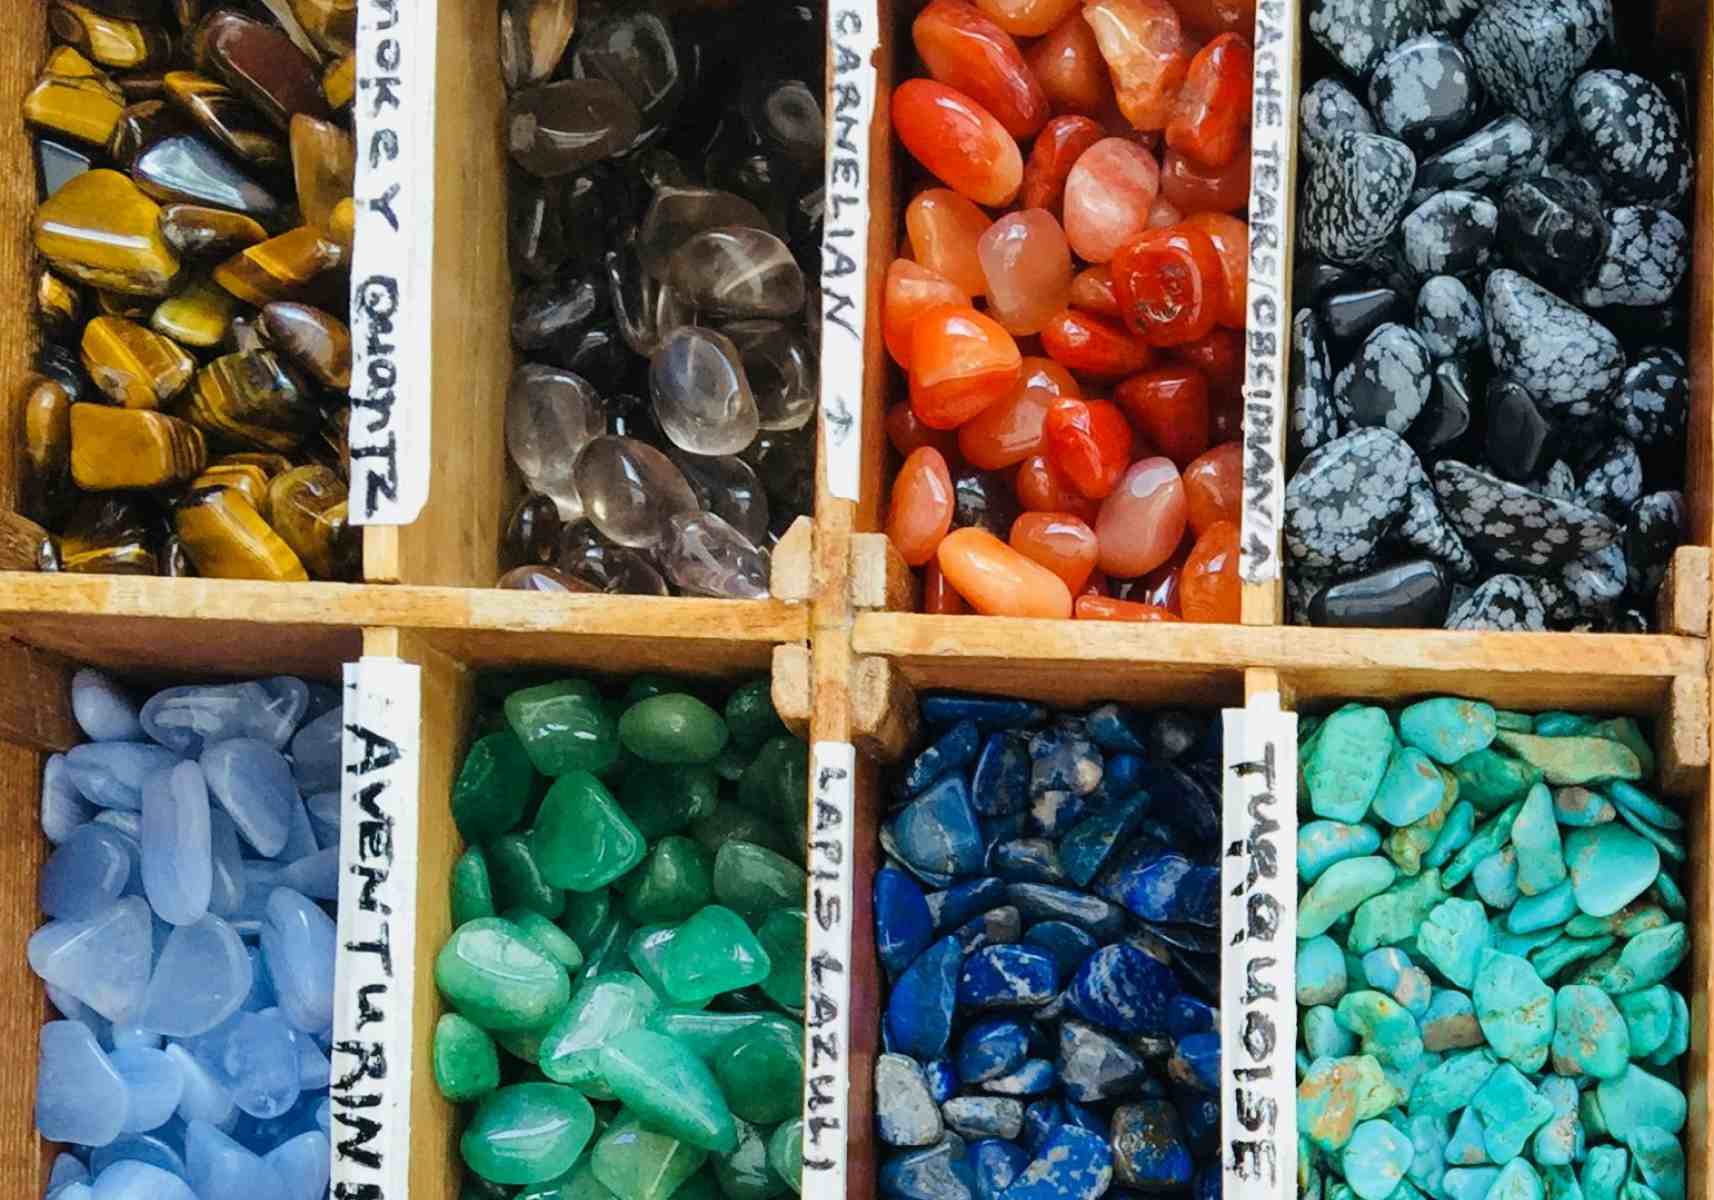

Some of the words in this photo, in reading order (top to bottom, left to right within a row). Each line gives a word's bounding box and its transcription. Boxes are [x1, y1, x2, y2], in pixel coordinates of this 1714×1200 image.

[822, 8, 863, 341] CARNELIAN
[808, 766, 848, 931] LAPIS
[1225, 742, 1286, 1191] TURQUOISE
[801, 950, 845, 1172] LAZULI
